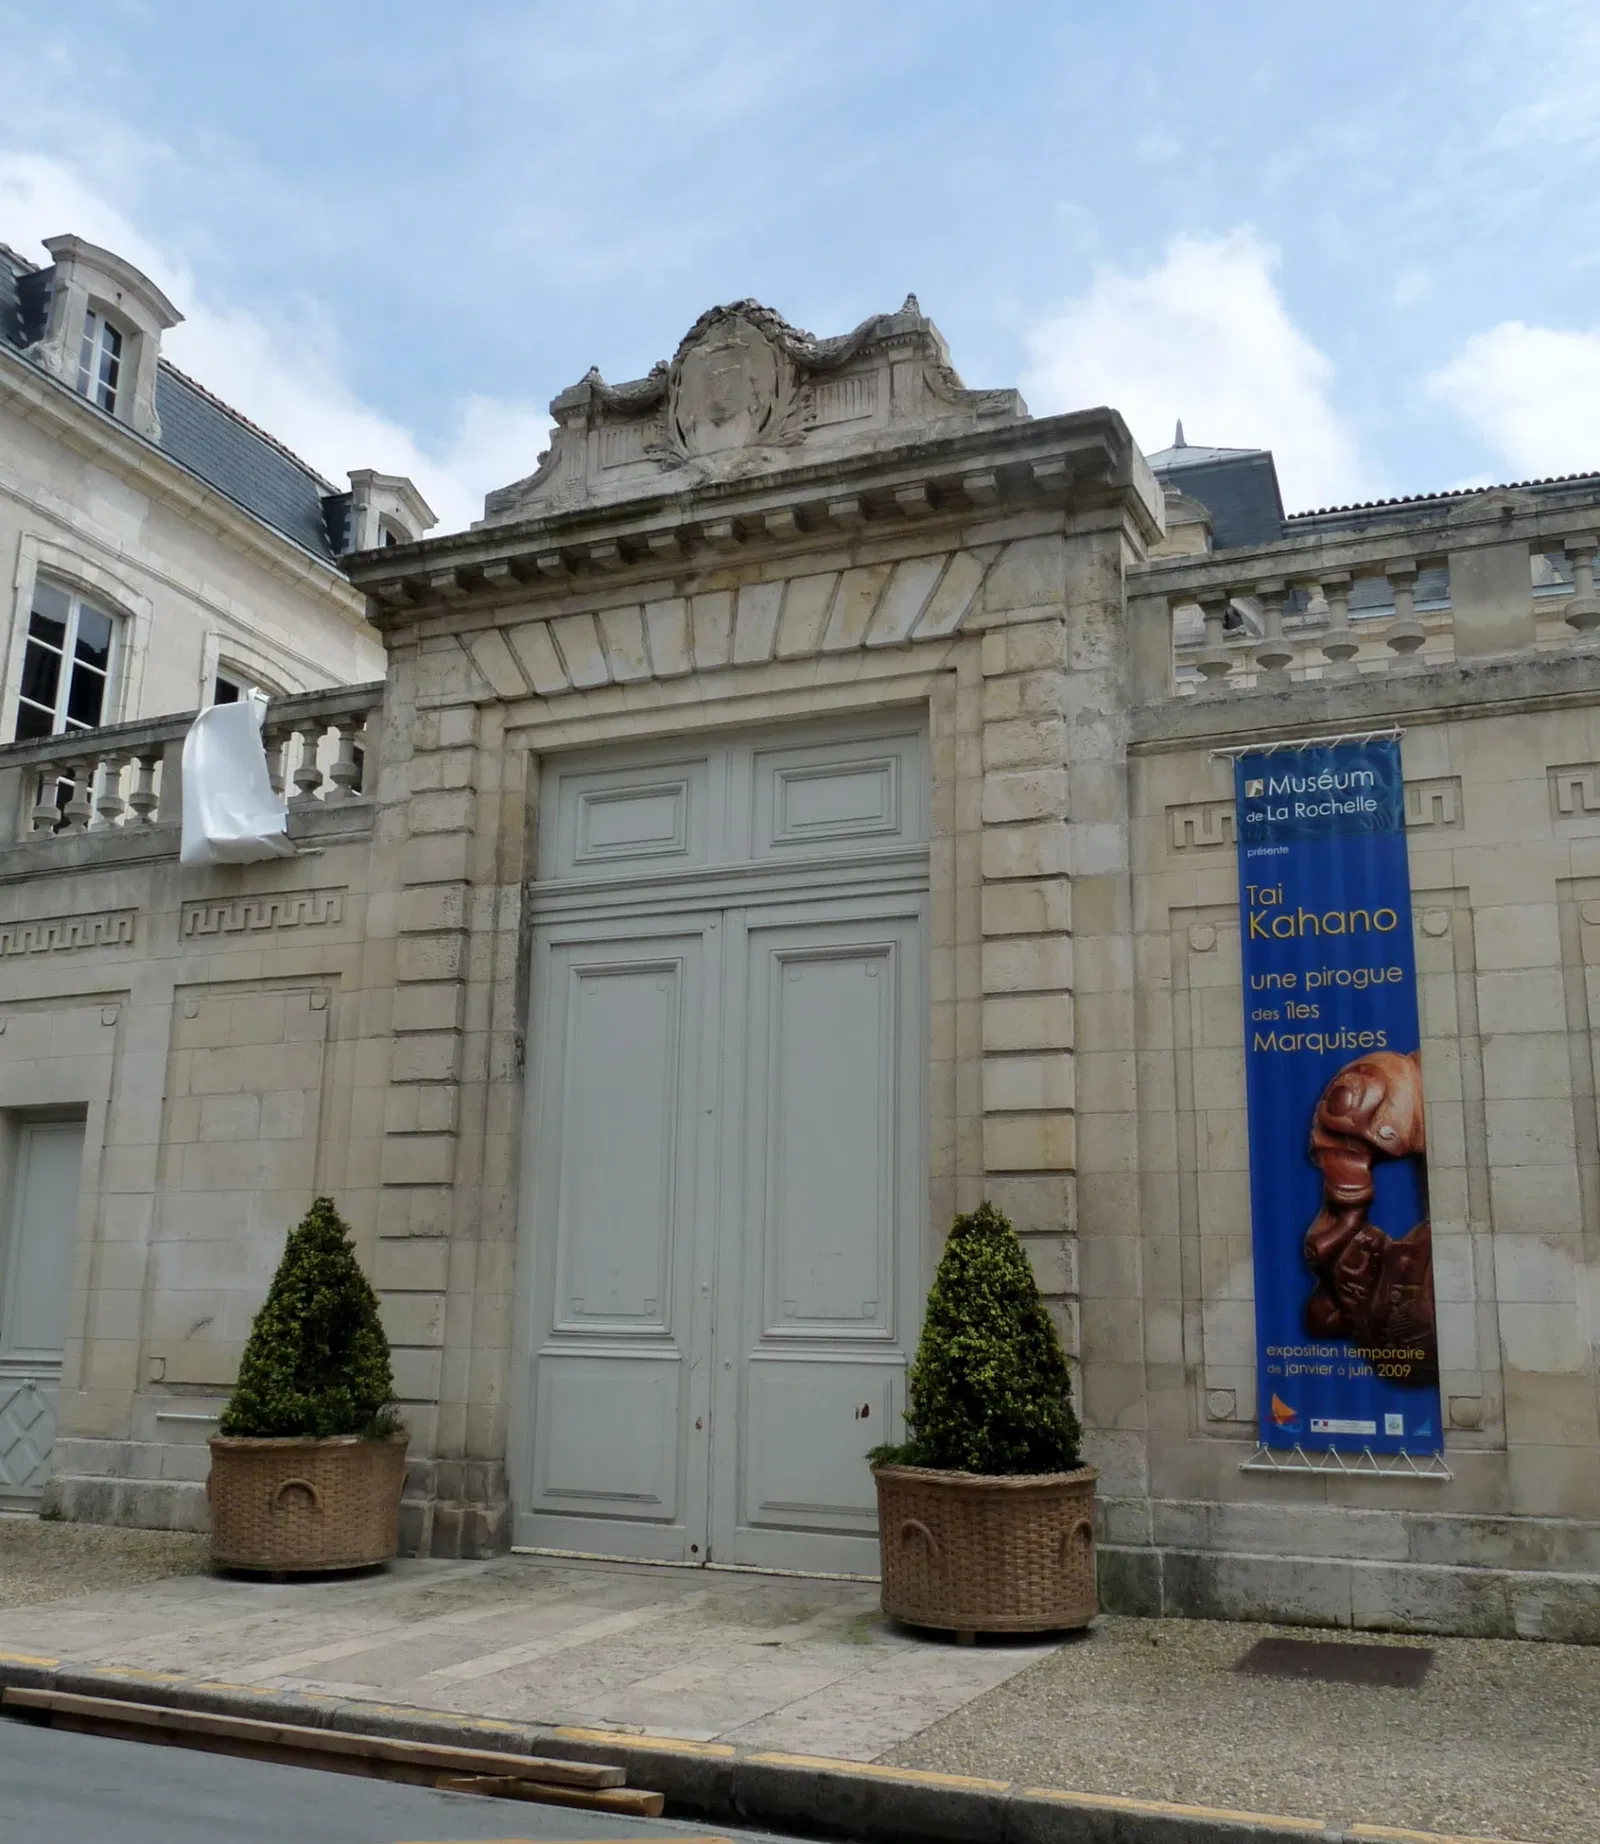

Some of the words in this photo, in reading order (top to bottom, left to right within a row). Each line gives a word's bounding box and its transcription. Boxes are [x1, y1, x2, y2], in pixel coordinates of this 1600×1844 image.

[1268, 768, 1374, 795] Muséum
[1246, 811, 1263, 822] de
[1267, 805, 1288, 821] La
[1295, 796, 1377, 818] Rochelle
[1247, 846, 1289, 858] présente
[1246, 883, 1283, 906] Tai
[1249, 906, 1397, 939] Kahano
[1251, 973, 1297, 990] une
[1305, 965, 1403, 992] pirogue
[1251, 1008, 1280, 1021] des
[1285, 1000, 1320, 1020] îles
[1254, 1026, 1387, 1055] Marquises
[1266, 1344, 1339, 1358] exposition
[1343, 1345, 1425, 1360] temporaire
[1267, 1363, 1281, 1373] de
[1284, 1362, 1333, 1376] janvier
[1337, 1365, 1345, 1375] à
[1348, 1364, 1373, 1379] juin
[1378, 1363, 1411, 1377] 2009
